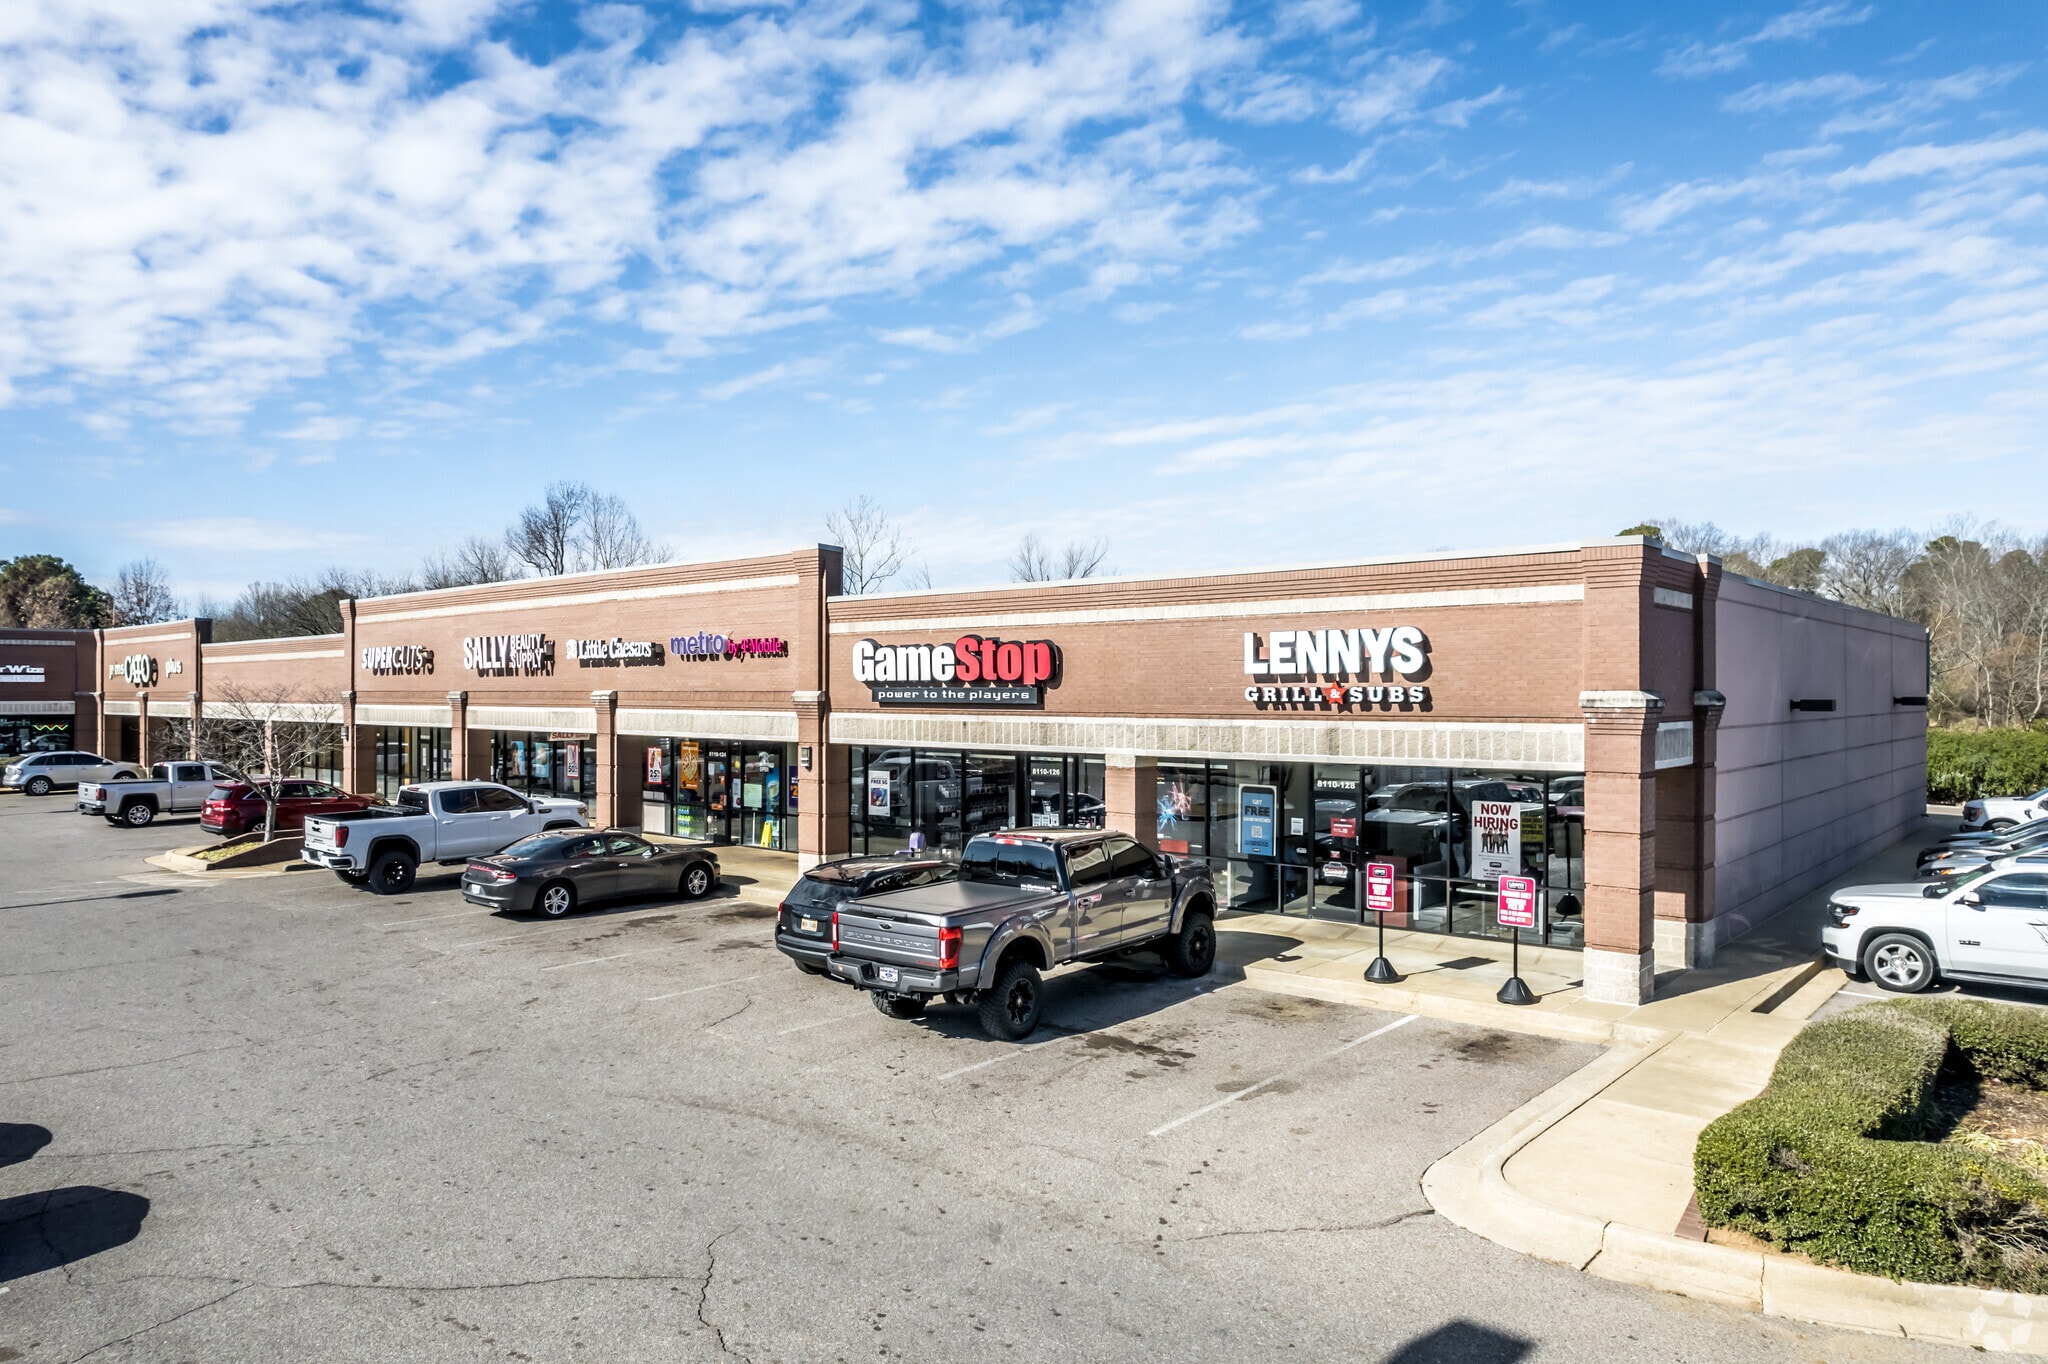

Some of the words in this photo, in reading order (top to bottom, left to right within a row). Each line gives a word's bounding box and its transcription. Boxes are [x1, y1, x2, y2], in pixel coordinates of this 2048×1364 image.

[510, 634, 542, 649] BEAUTY
[577, 639, 607, 660] Little
[608, 637, 652, 659] Caesars
[670, 631, 724, 655] metro
[727, 639, 738, 659] by
[1243, 626, 1424, 674] LENNYS
[361, 645, 423, 670] SUPERCUTS
[463, 636, 510, 670] SALLY
[510, 650, 542, 668] SUPPLY
[852, 636, 1051, 685] GameStop
[125, 654, 150, 683] CATO
[165, 657, 182, 678] plus
[878, 690, 919, 700] power
[924, 690, 938, 699] to
[942, 689, 966, 699] the
[969, 690, 1030, 701] players
[1244, 686, 1323, 702] GRILL
[1329, 688, 1341, 699] &
[1349, 686, 1425, 703] SUBS
[1316, 780, 1356, 789] 8110-128
[1244, 805, 1271, 817] FREE
[1480, 803, 1512, 816] NOW
[1474, 816, 1519, 830] HIRING
